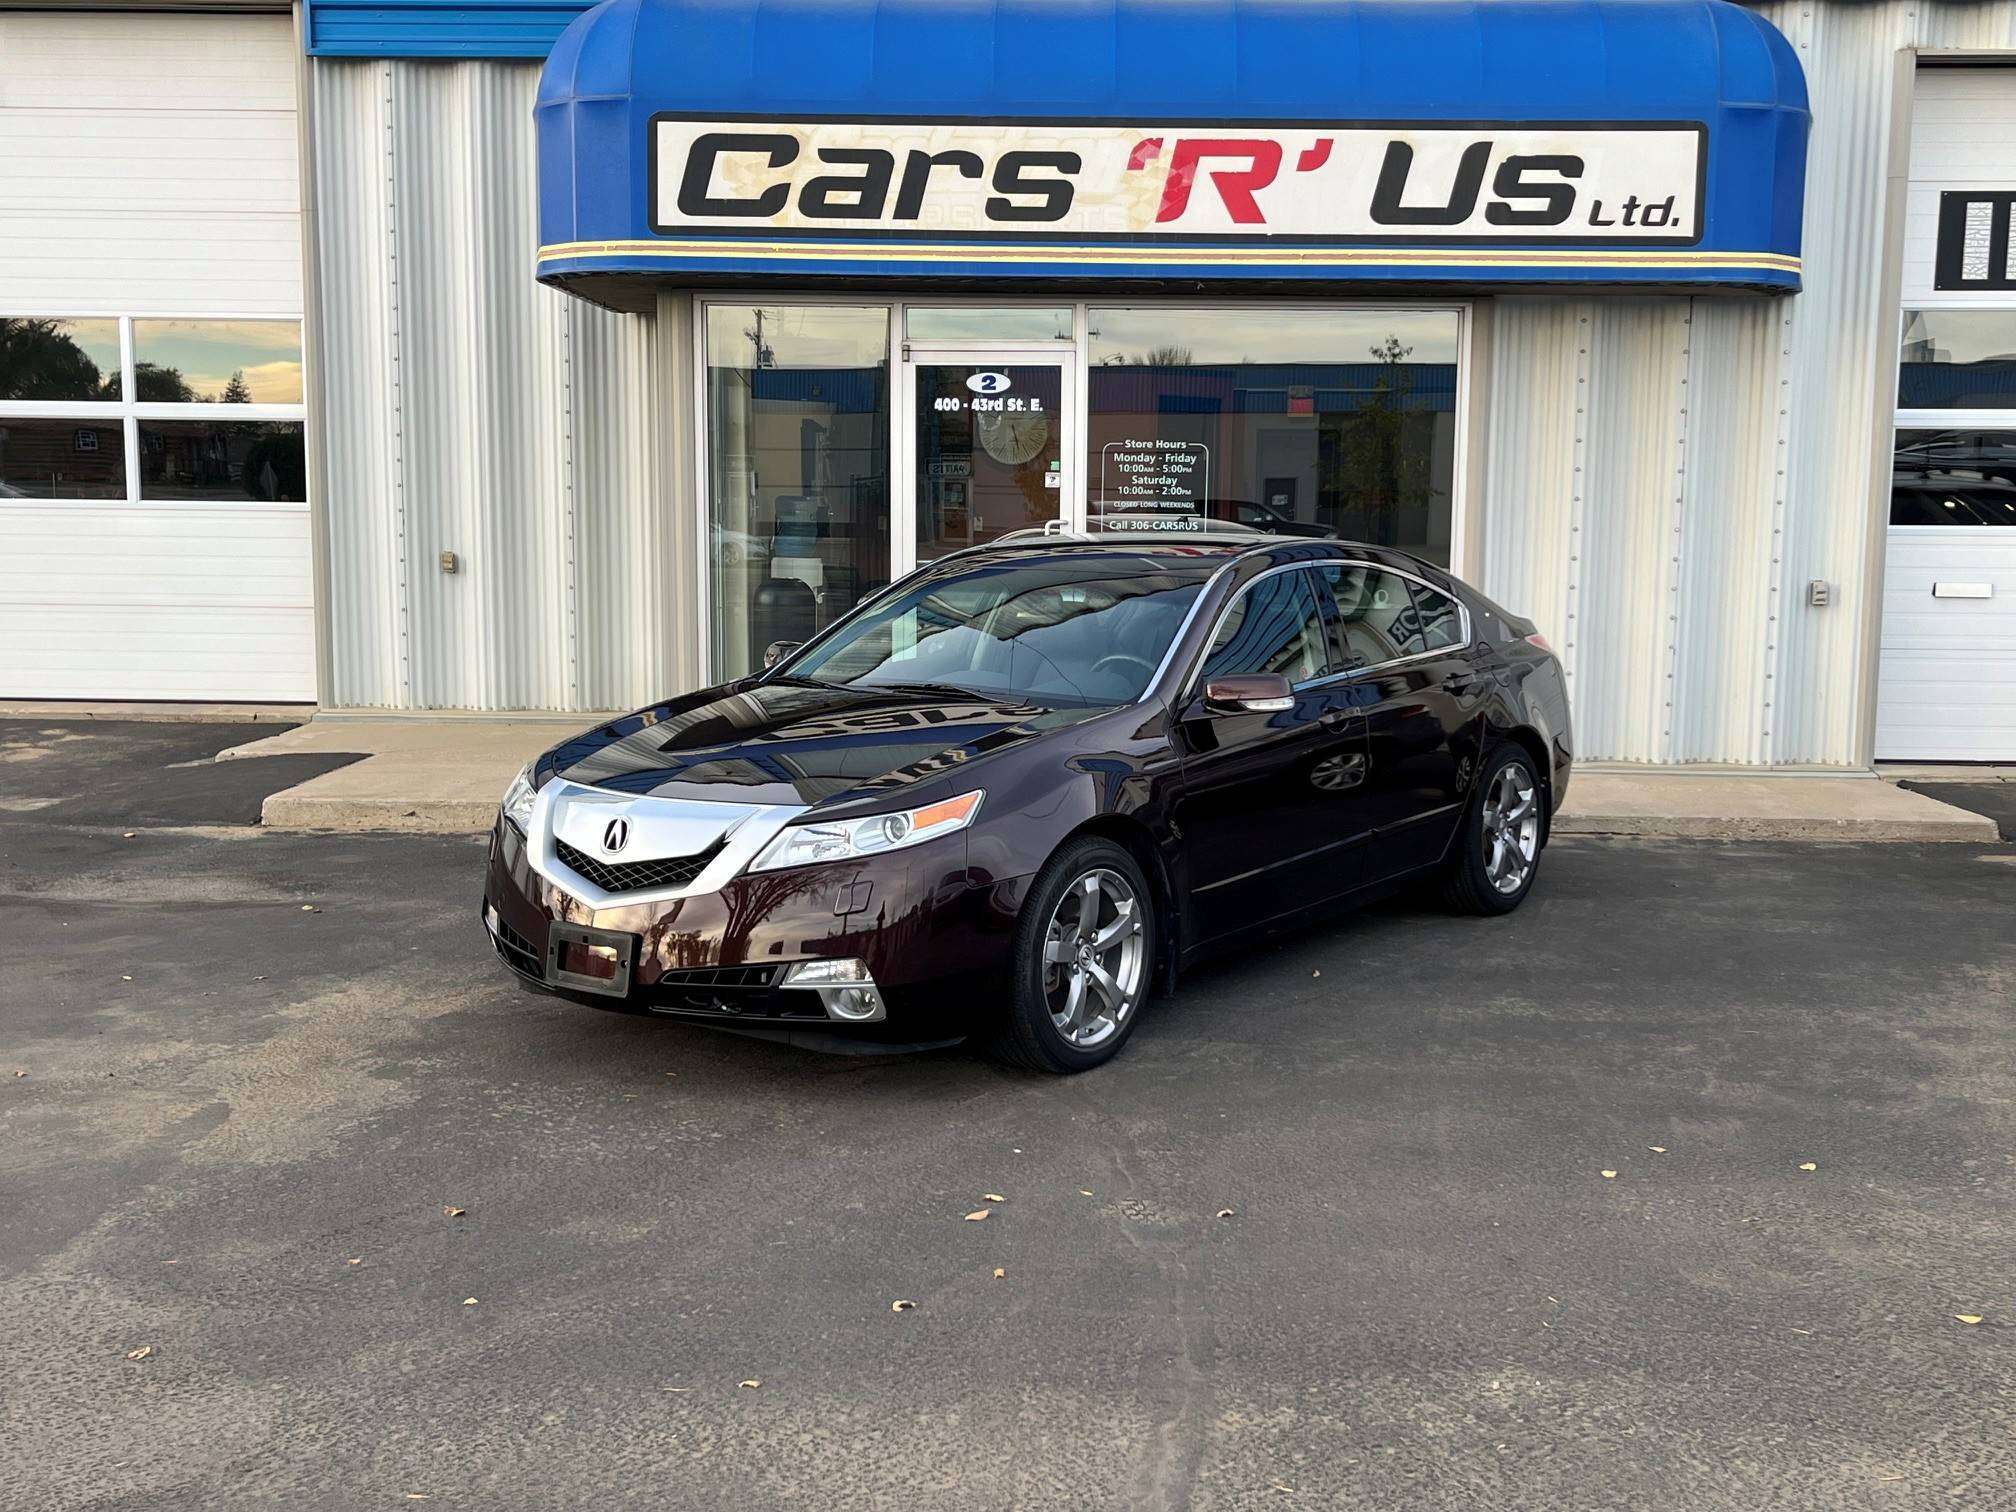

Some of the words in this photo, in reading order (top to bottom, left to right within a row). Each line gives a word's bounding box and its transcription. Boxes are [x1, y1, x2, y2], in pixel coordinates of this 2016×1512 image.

[677, 133, 1082, 221] Cars
[1370, 140, 1585, 226] Us
[1588, 195, 1680, 227] Ltd.
[981, 374, 997, 391] 2
[934, 397, 960, 412] 400
[971, 397, 1004, 412] 43rd
[1007, 397, 1027, 412] St.
[1030, 397, 1044, 412] E.
[1124, 439, 1154, 449] Store
[1155, 440, 1187, 449] Hours
[1113, 453, 1156, 464] Monday
[1165, 453, 1197, 465] Friday
[1131, 475, 1178, 486] Saturday
[1109, 520, 1128, 530] Call
[1130, 521, 1199, 531] 306-CARSRUS
